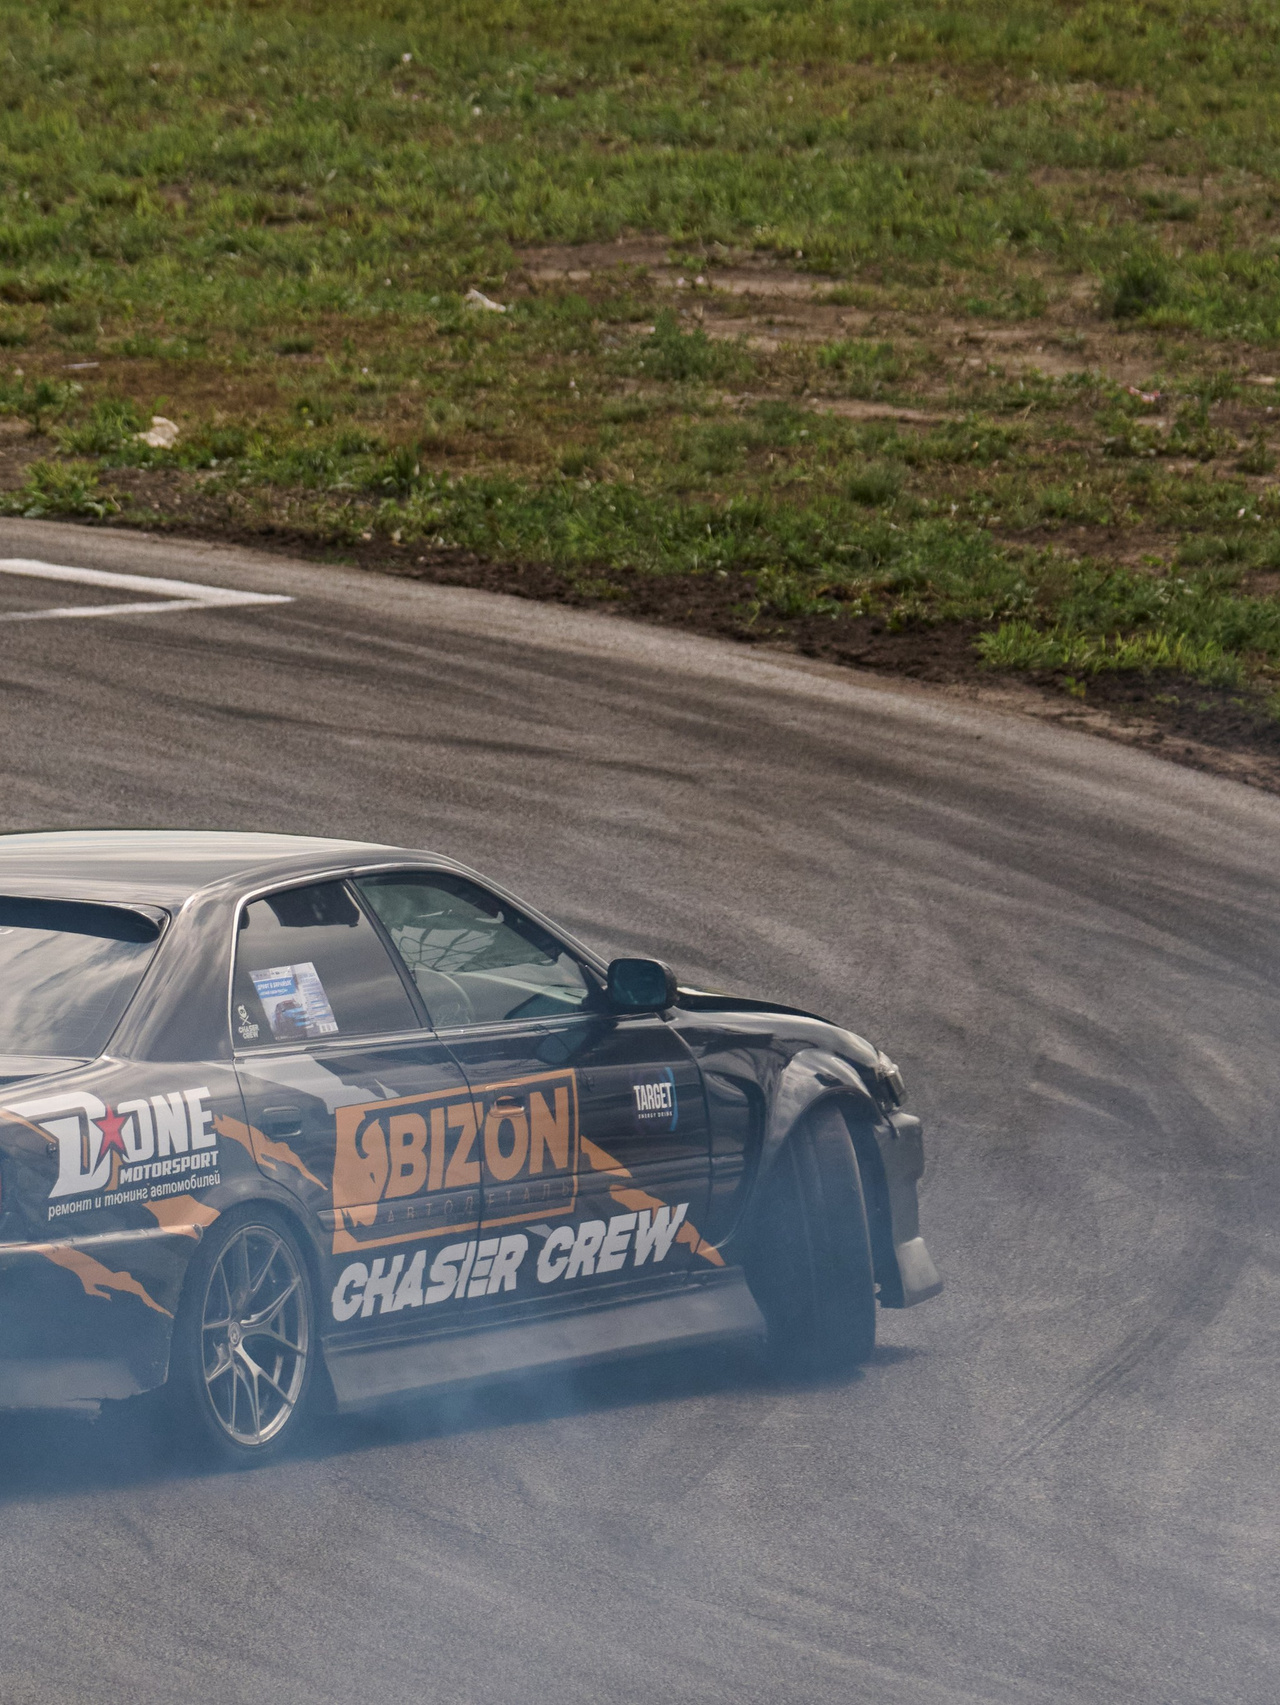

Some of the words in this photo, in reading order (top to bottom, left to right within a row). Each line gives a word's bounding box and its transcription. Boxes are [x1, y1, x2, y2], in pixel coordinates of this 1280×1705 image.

[633, 1082, 672, 1111] TARGET
[120, 1150, 219, 1185] MOTORSPORT
[384, 1086, 570, 1199] BIZON
[47, 1199, 92, 1221] ремонт
[94, 1196, 102, 1208] и
[104, 1187, 149, 1207] тюнинг
[150, 1169, 221, 1198] автомобилей
[537, 1202, 690, 1284] CREW
